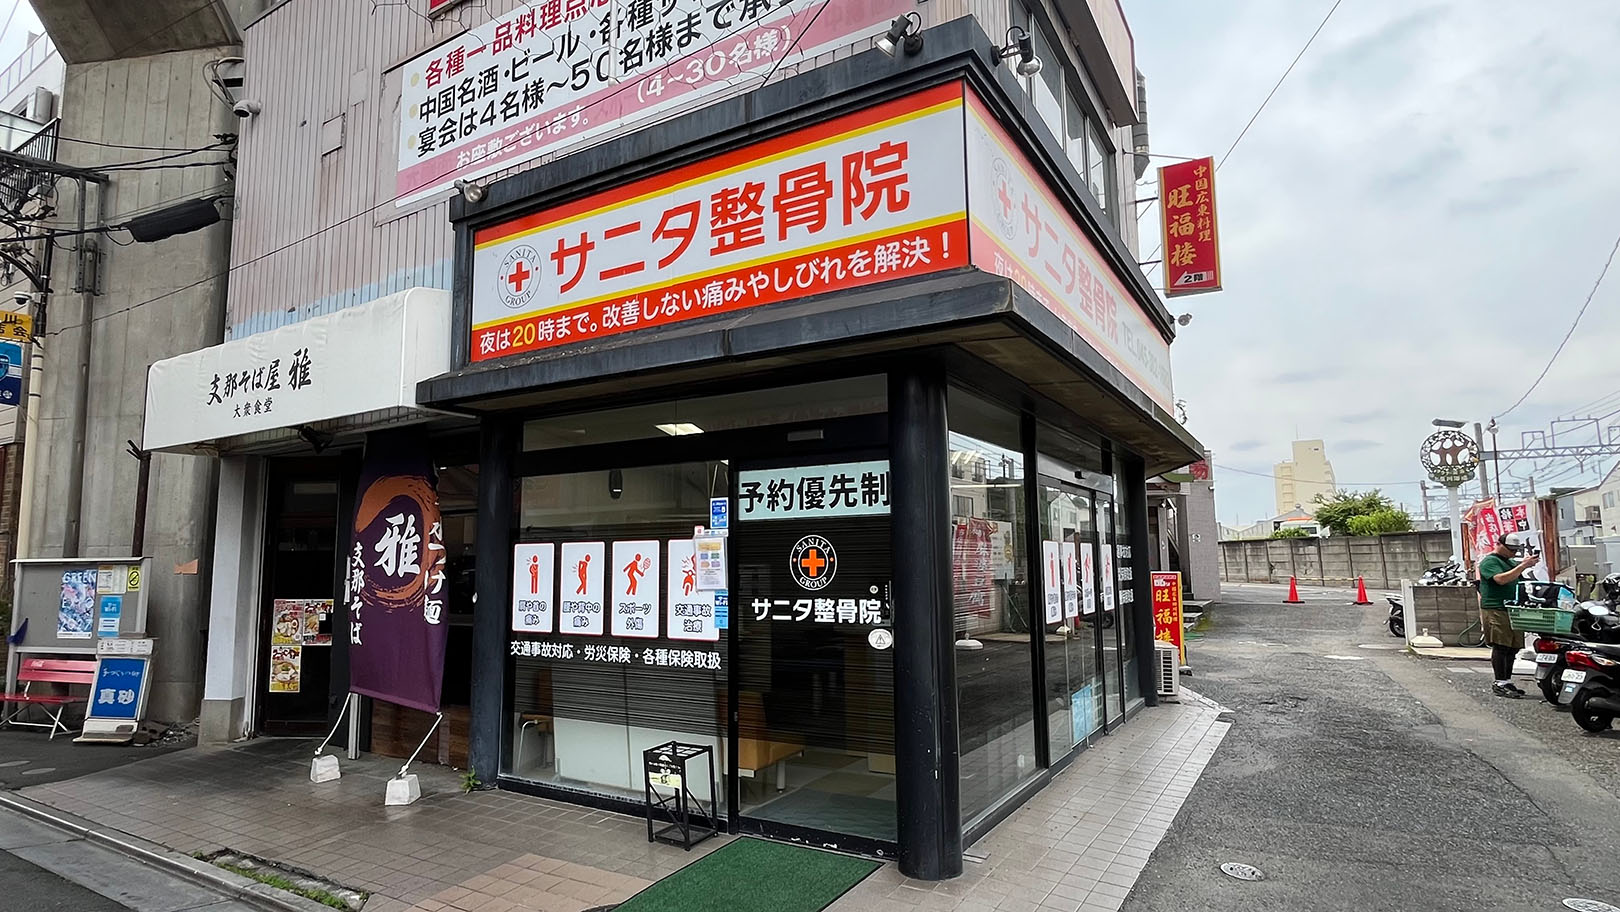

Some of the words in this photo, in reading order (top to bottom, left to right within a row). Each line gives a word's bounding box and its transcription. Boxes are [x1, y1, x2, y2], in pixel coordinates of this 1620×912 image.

[1193, 164, 1212, 243] 中国広東料理
[550, 140, 911, 295] サニタ整骨院
[1167, 183, 1198, 268] 旺福楼
[504, 248, 536, 268] SANITA
[1021, 190, 1119, 345] サニタ整骨院
[478, 231, 952, 355] 夜は20時まで。改善しない痛みやしびれを解決！
[505, 290, 532, 306] GROUP
[206, 358, 282, 407] 支那そば屋
[287, 347, 312, 391] 雅
[738, 471, 890, 514] 予約優先制
[374, 512, 421, 578] 雅
[796, 537, 831, 553] SANITA
[348, 541, 366, 646] 支那そば
[799, 575, 828, 589] GROUP
[524, 614, 541, 626] 痛み
[618, 602, 652, 615] スポーツ
[674, 603, 712, 618] 交通事故
[751, 597, 882, 624] サニタ整骨院
[573, 616, 590, 629] 痛み
[625, 617, 645, 631] 外傷
[683, 620, 703, 634] 治療
[509, 639, 723, 671] 交通事故対応・労災保険・各種保険取扱
